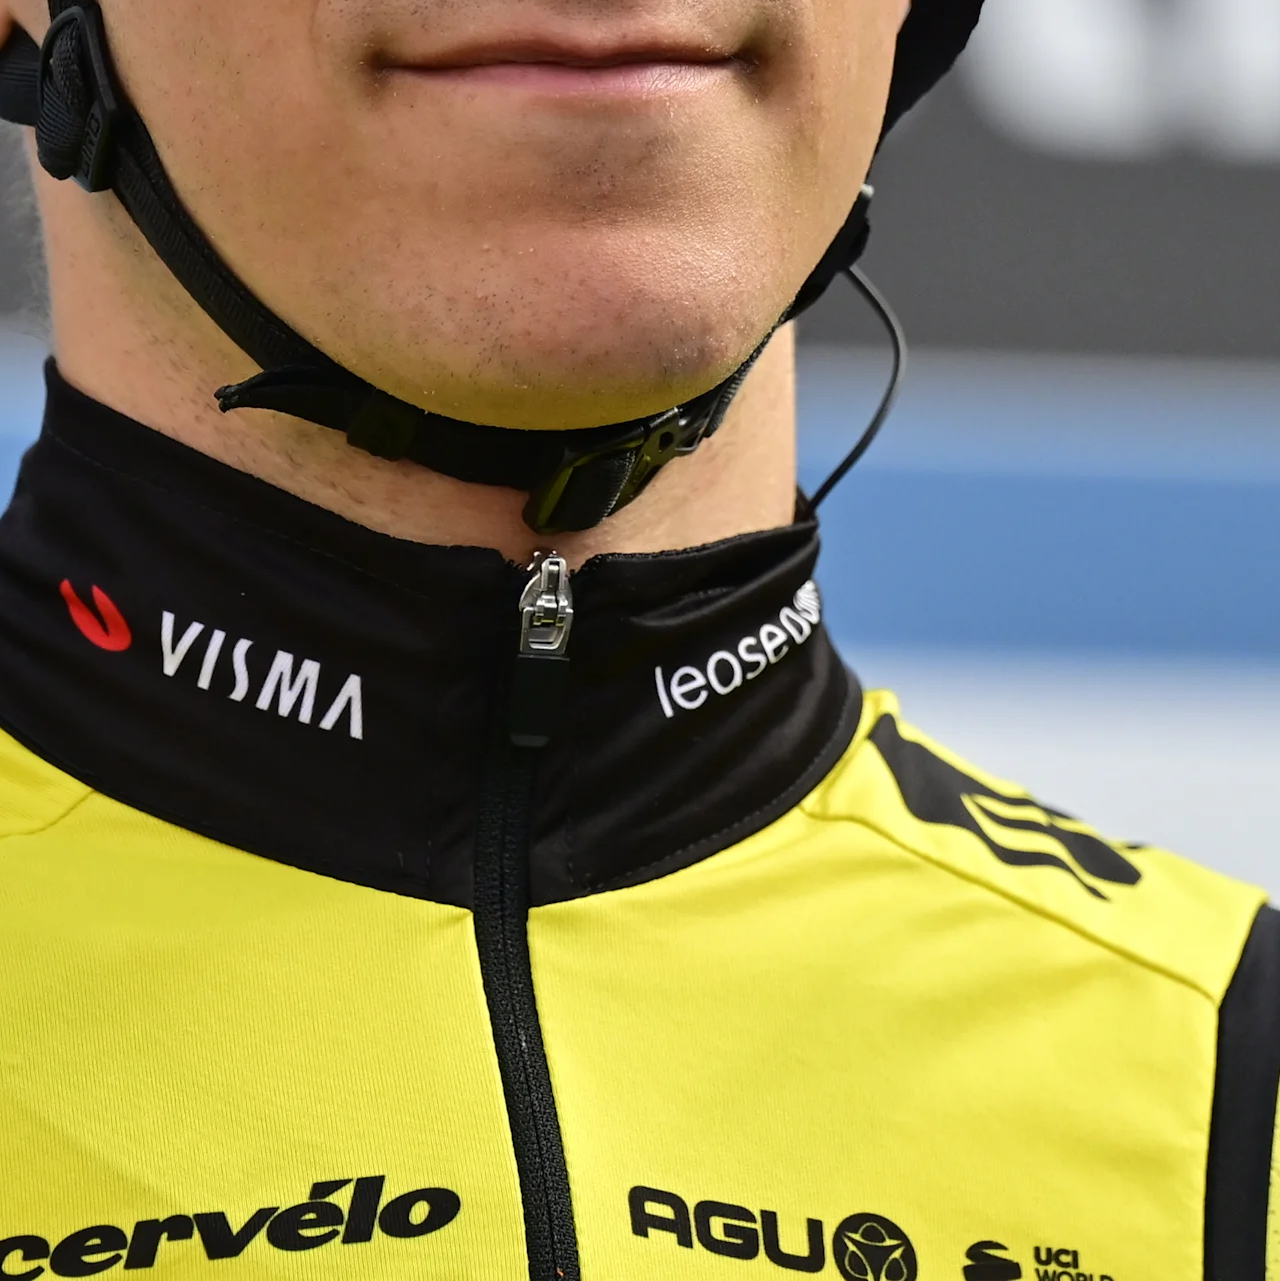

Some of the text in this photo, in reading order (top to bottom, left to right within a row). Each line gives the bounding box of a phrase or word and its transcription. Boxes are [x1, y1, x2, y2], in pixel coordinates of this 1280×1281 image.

[161, 610, 363, 740] VISMA
[628, 1185, 825, 1273] AGU
[1034, 1246, 1079, 1269] UCI
